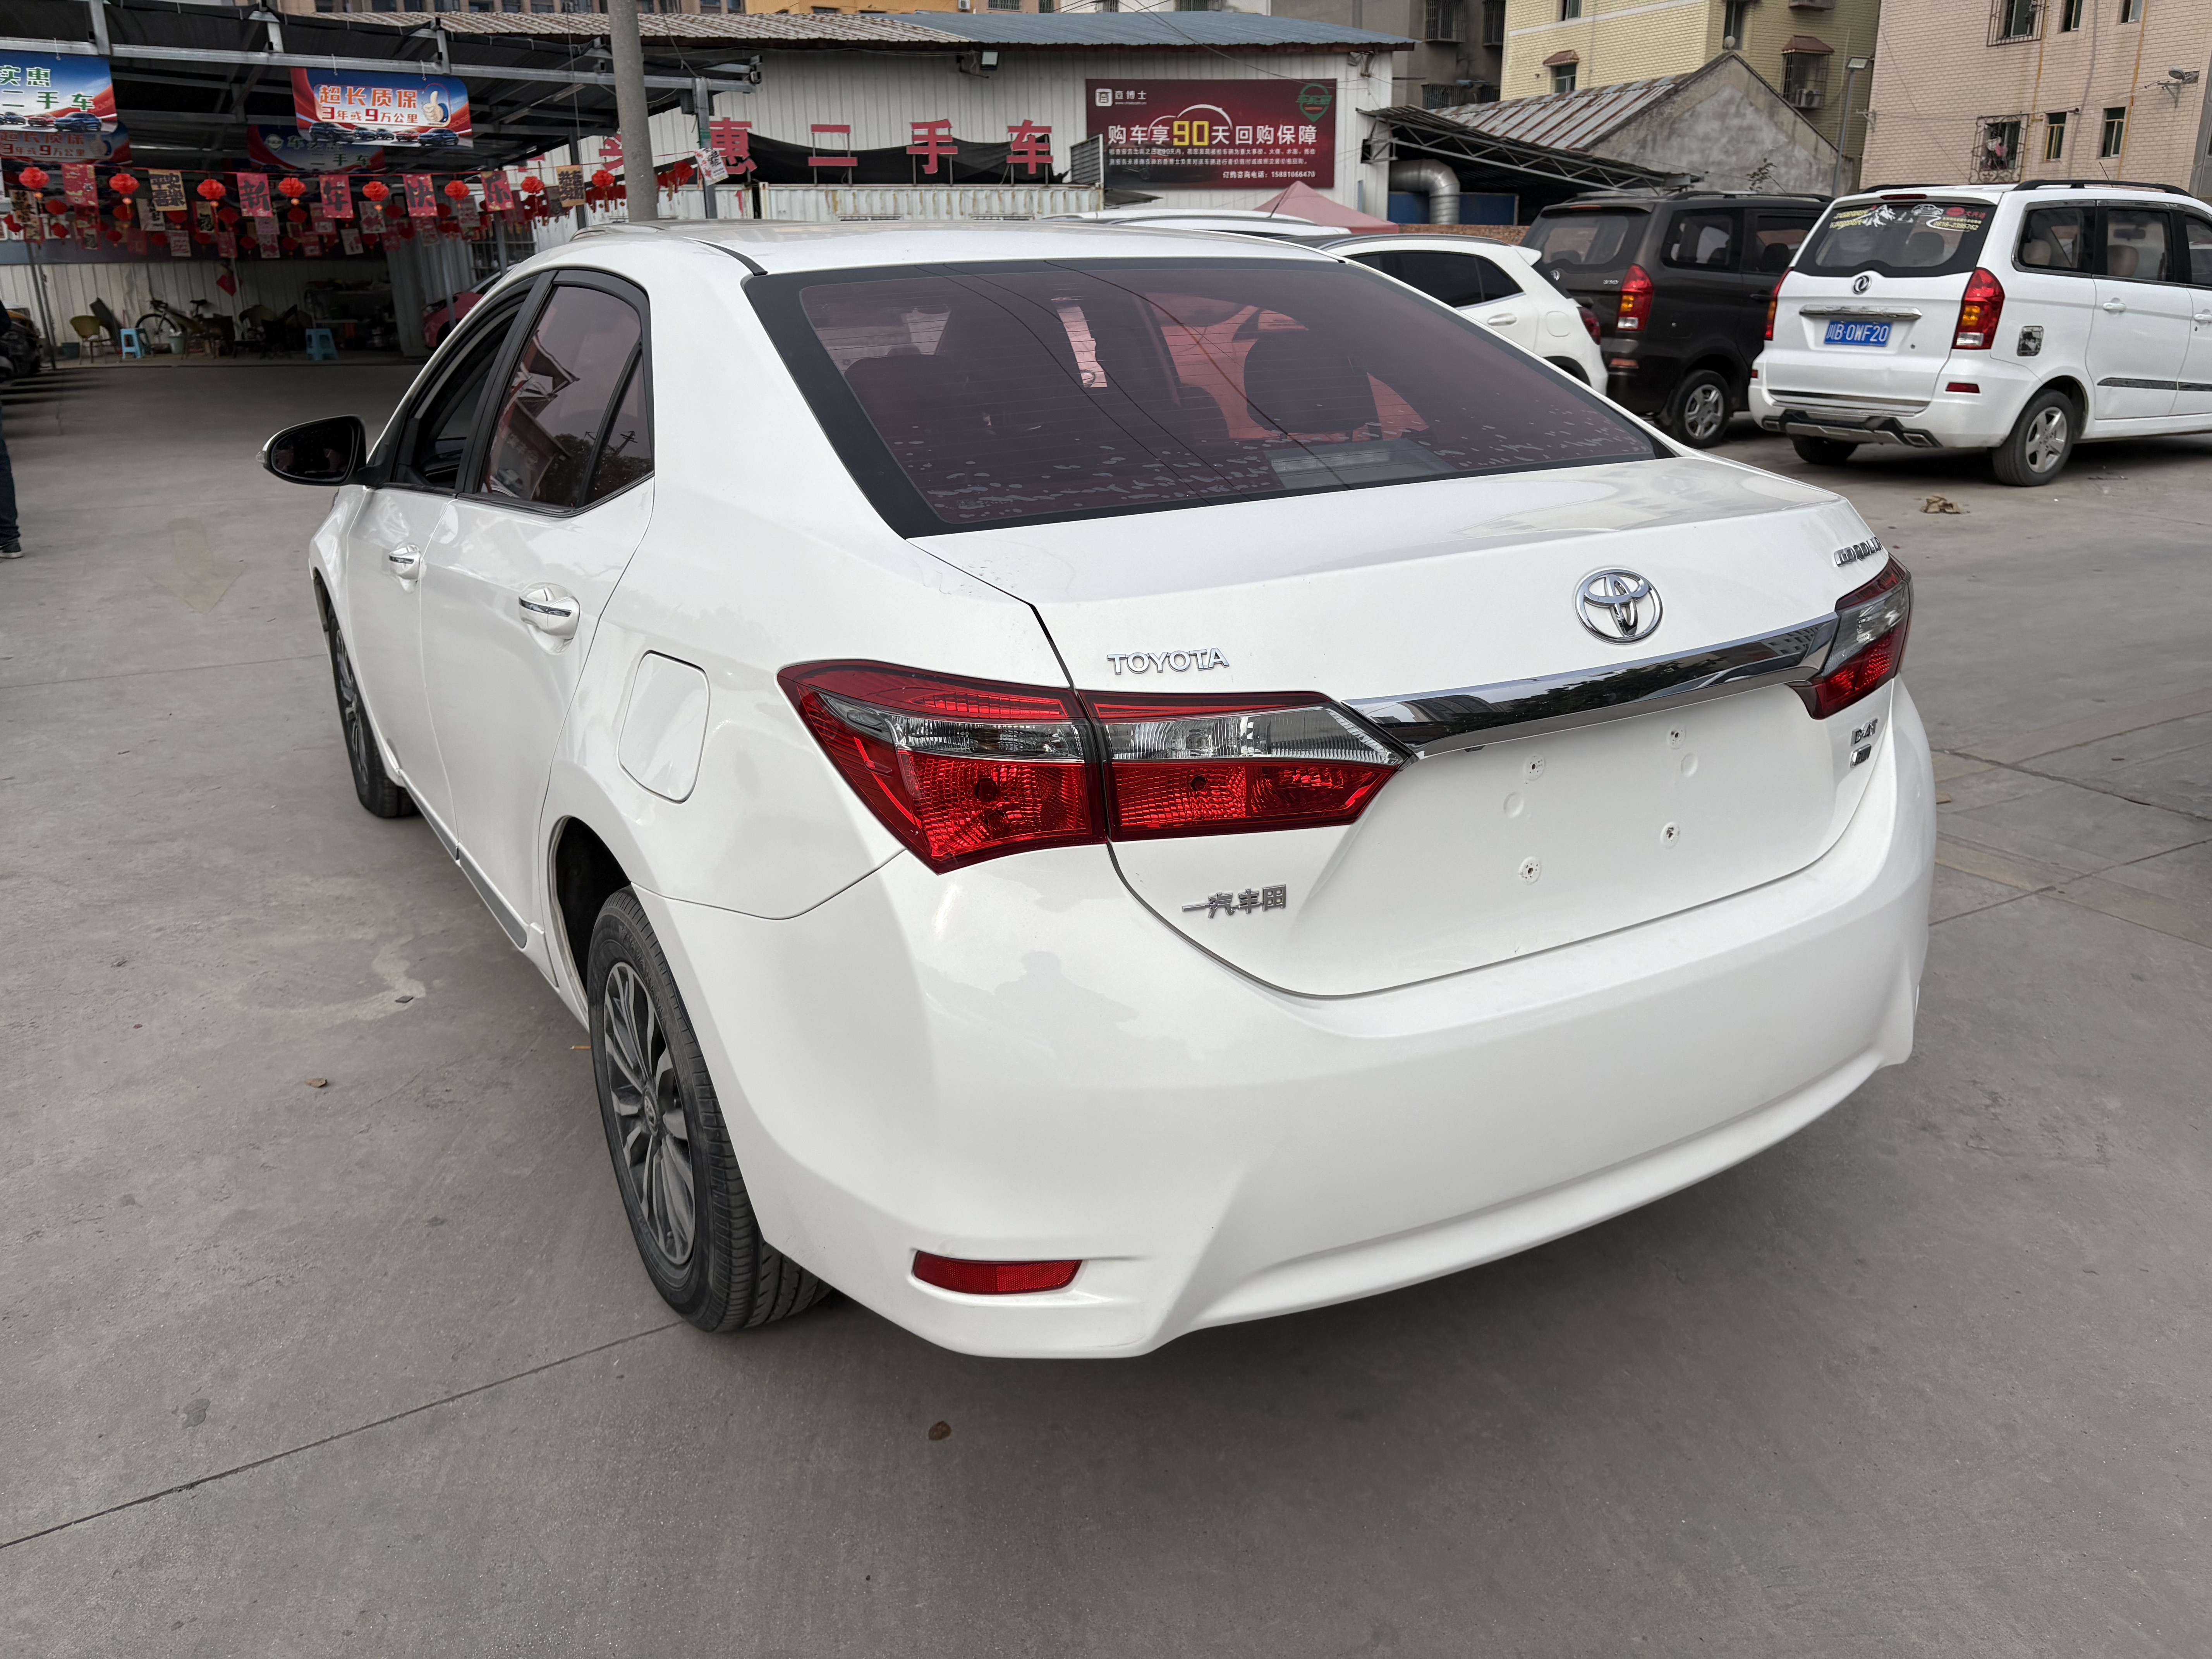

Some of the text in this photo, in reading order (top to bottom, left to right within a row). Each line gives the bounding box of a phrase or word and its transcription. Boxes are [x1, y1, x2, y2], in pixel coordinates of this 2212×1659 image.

[0, 65, 51, 87] 实惠
[2, 90, 95, 112] 二手车
[319, 84, 418, 109] 超长质保
[321, 106, 418, 124] 3年或9万公里
[1108, 120, 1317, 146] 购车享90天回购保障
[240, 180, 271, 211] 新
[323, 181, 348, 211] 年
[406, 180, 433, 208] 快
[1106, 647, 1230, 675] TOYOTA
[1182, 884, 1286, 919] 一汽丰田
